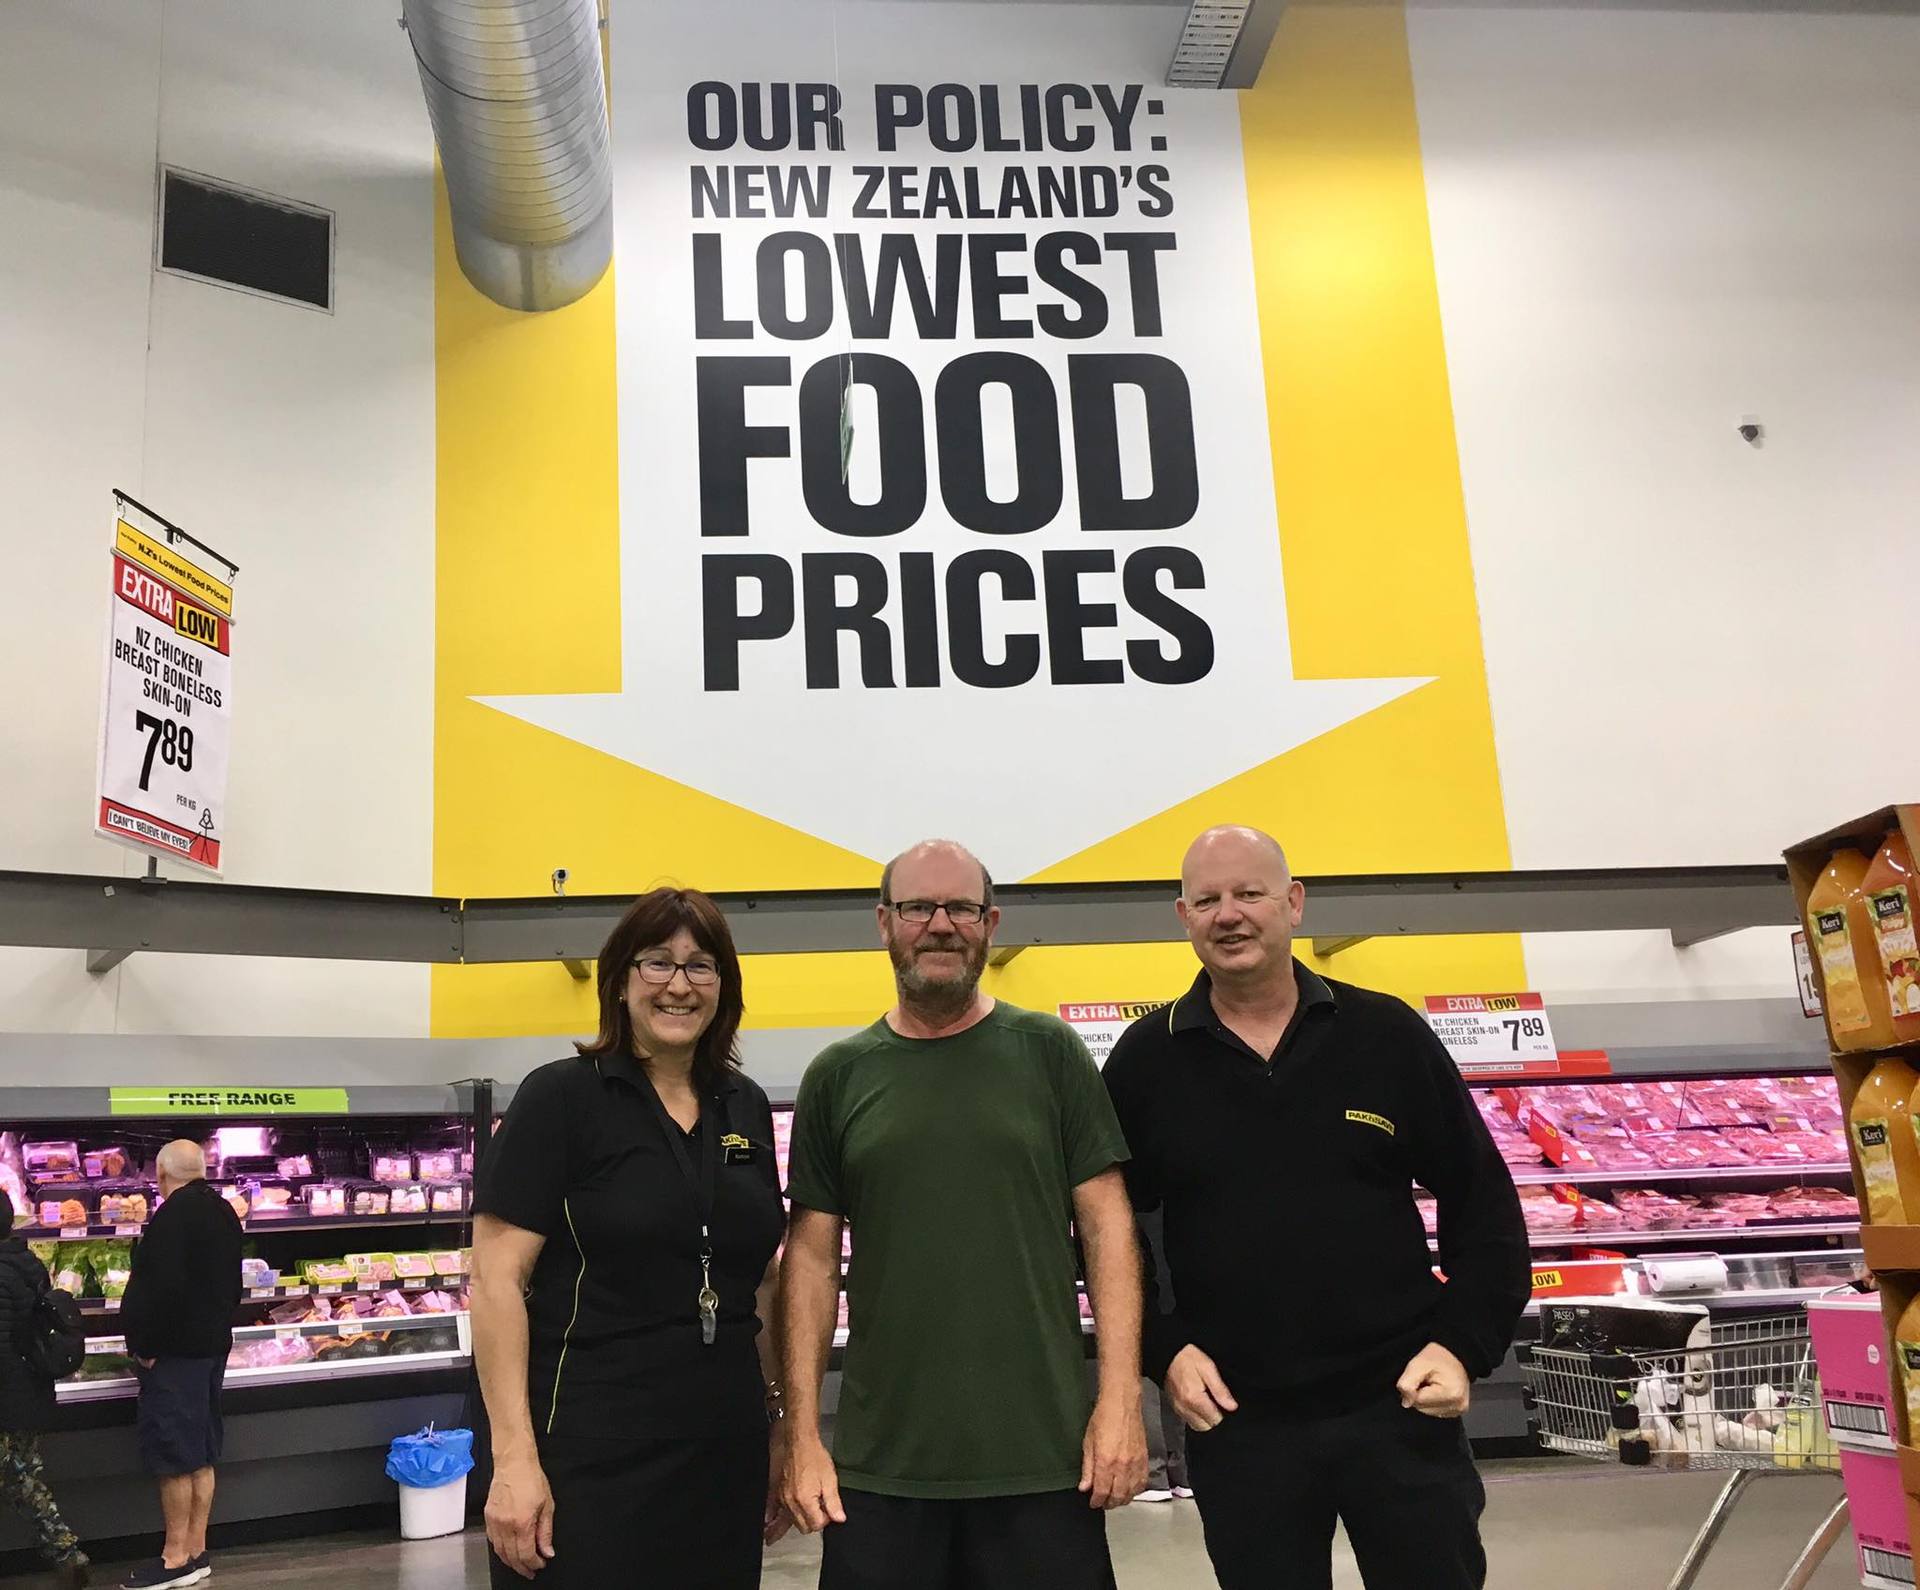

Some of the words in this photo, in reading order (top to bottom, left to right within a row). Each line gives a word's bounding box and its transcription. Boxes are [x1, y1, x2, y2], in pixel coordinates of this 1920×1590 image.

[687, 81, 845, 151] OUR
[874, 83, 1168, 152] POLICY:
[690, 165, 831, 218] NEW
[852, 164, 1174, 218] ZEALAND'S
[692, 230, 1177, 340] LOWEST
[695, 351, 1199, 537] FOOD
[159, 556, 186, 578] Lowest
[187, 572, 205, 590] Food
[206, 584, 229, 604] Prices
[121, 564, 173, 620] EXTRA
[178, 605, 216, 643] LOW
[701, 546, 1215, 691] PRICES
[136, 626, 151, 650] NZ
[154, 637, 203, 677] CHICKEN
[115, 638, 160, 677] BREAST
[163, 664, 222, 708] BONELESS
[143, 678, 191, 717] SKIN-ON
[1821, 915, 1841, 929] Keri
[1878, 897, 1901, 911] Keri
[1068, 1005, 1120, 1019] EXTRA
[1432, 1018, 1442, 1027] NZ
[1445, 1017, 1479, 1027] CHICKEN
[1446, 997, 1485, 1011] EXTRA
[1487, 997, 1517, 1011] LOW
[1434, 1027, 1464, 1036] BREAST
[1467, 1026, 1500, 1036] SKIN-ON
[1440, 1036, 1478, 1046] ONELESS
[168, 1092, 221, 1106] FREE
[227, 1092, 296, 1106] RANGE
[1532, 1273, 1556, 1287] OW
